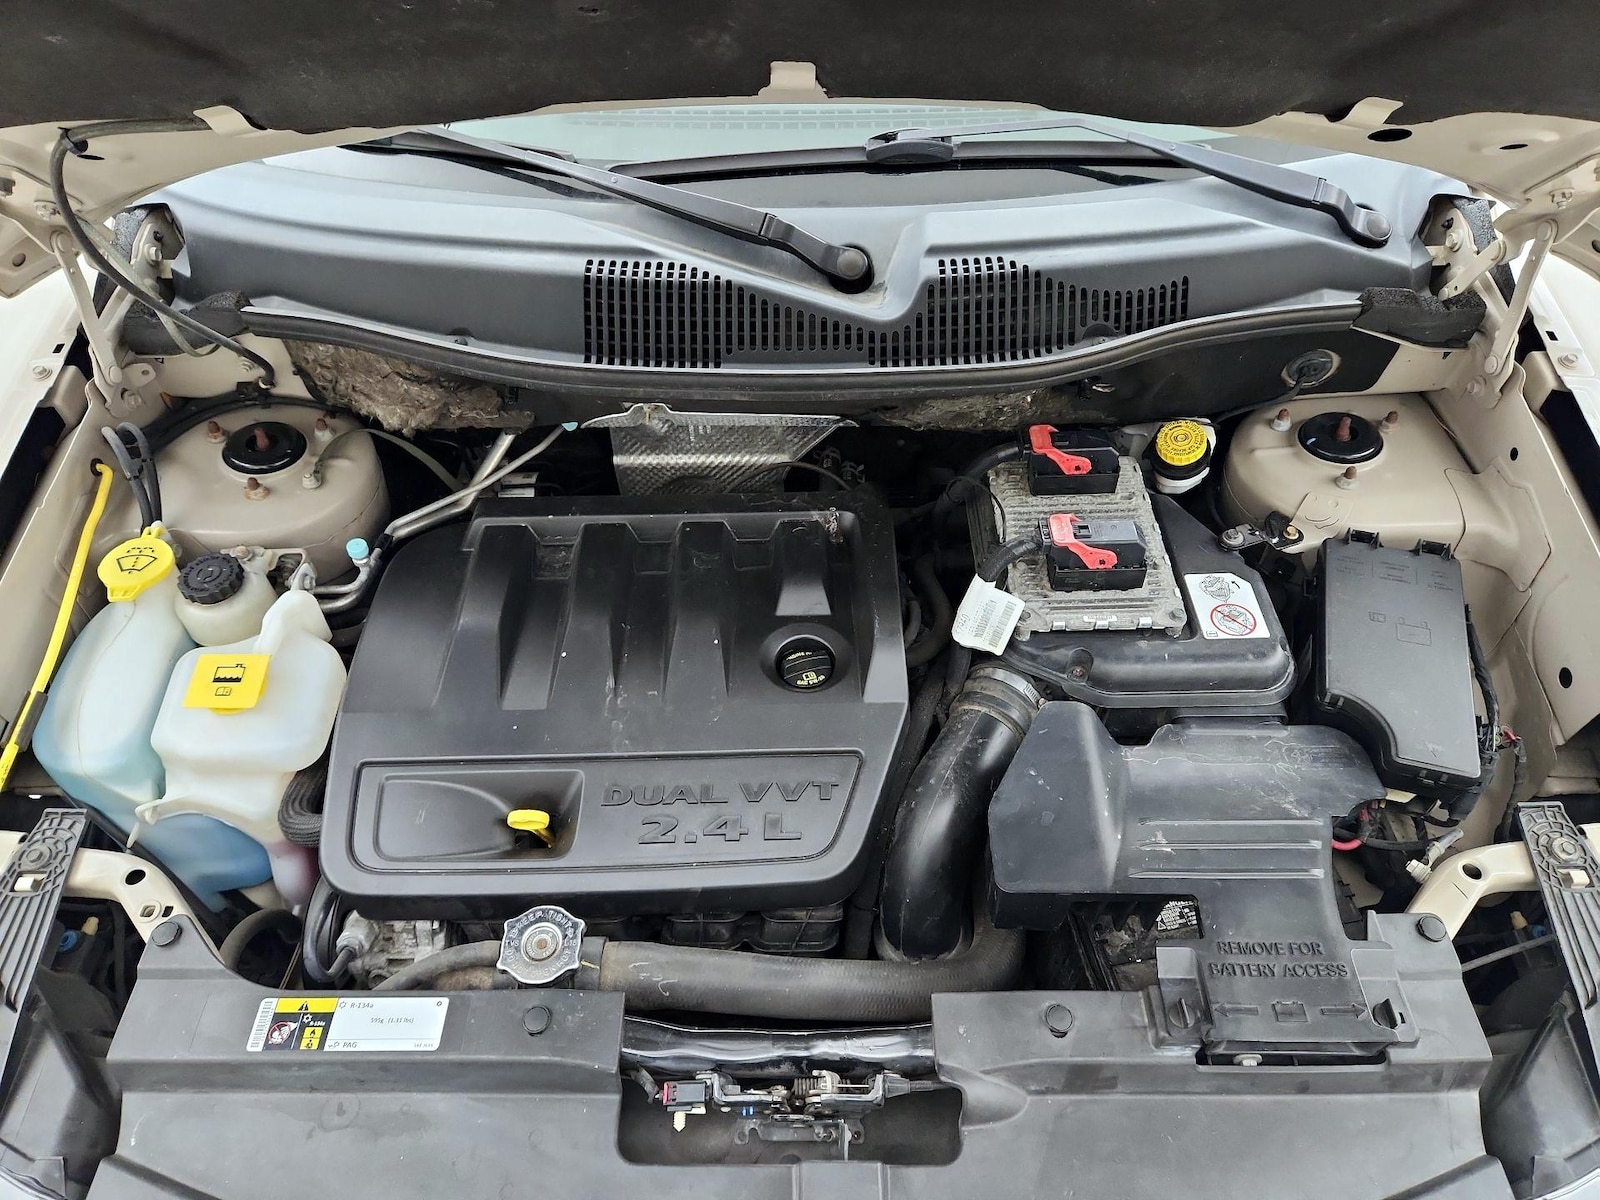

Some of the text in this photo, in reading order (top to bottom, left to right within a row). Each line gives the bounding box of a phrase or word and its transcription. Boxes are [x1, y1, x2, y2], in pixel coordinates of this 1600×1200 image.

[601, 781, 839, 806] DUAL VVT
[638, 812, 803, 844] 2.4 L
[516, 910, 573, 929] KEEP TIGHT
[1216, 940, 1325, 956] REMOVE FOR
[1208, 962, 1348, 978] BATTERY ACCESS
